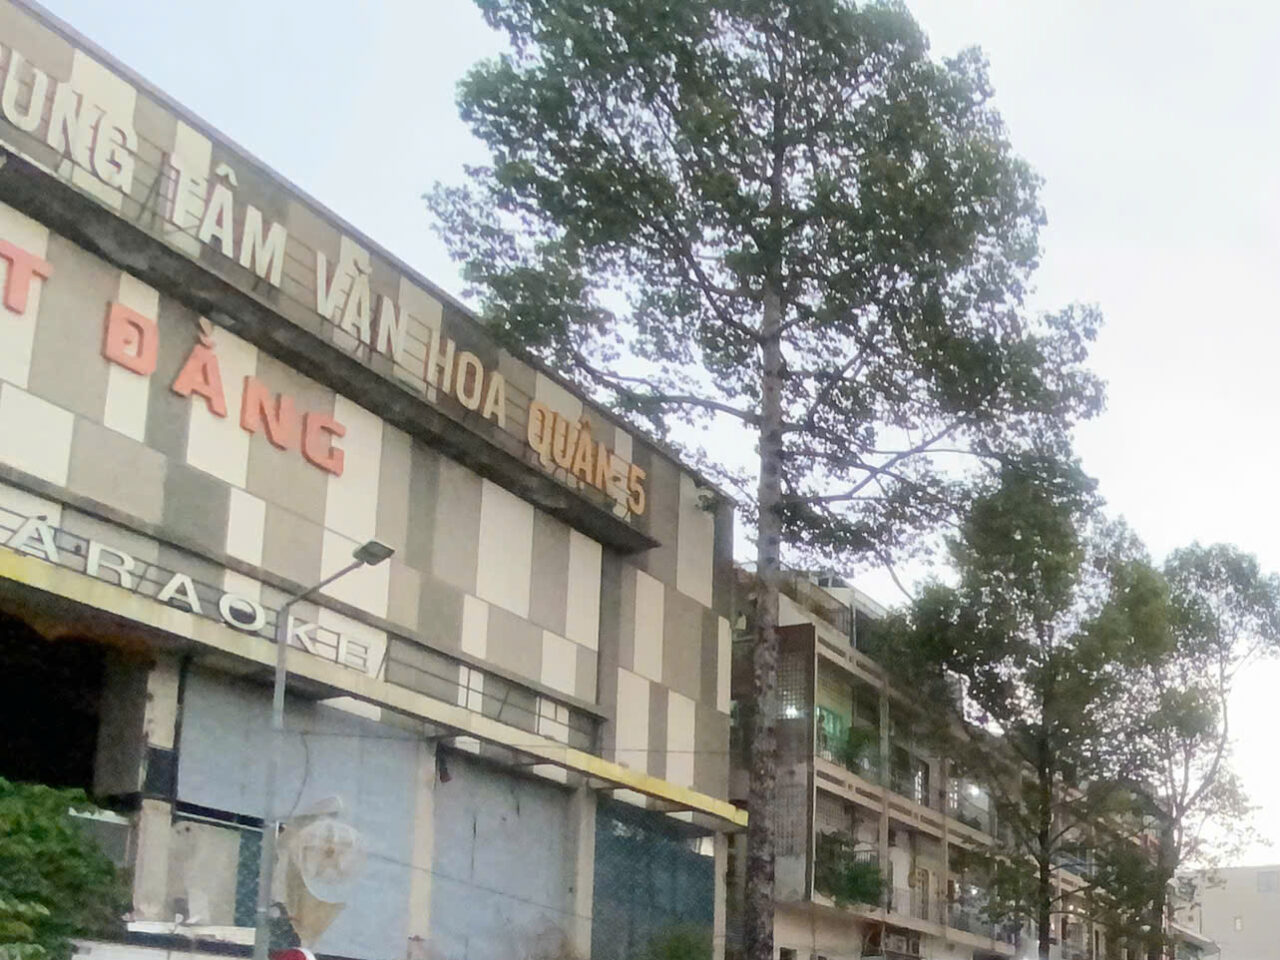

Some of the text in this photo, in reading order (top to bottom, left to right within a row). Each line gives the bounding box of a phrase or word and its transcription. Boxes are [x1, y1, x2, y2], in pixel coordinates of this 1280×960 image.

[167, 148, 288, 288] TÂM
[316, 250, 409, 362] VĂN
[527, 400, 618, 501] QUÂN
[627, 463, 648, 516] 5
